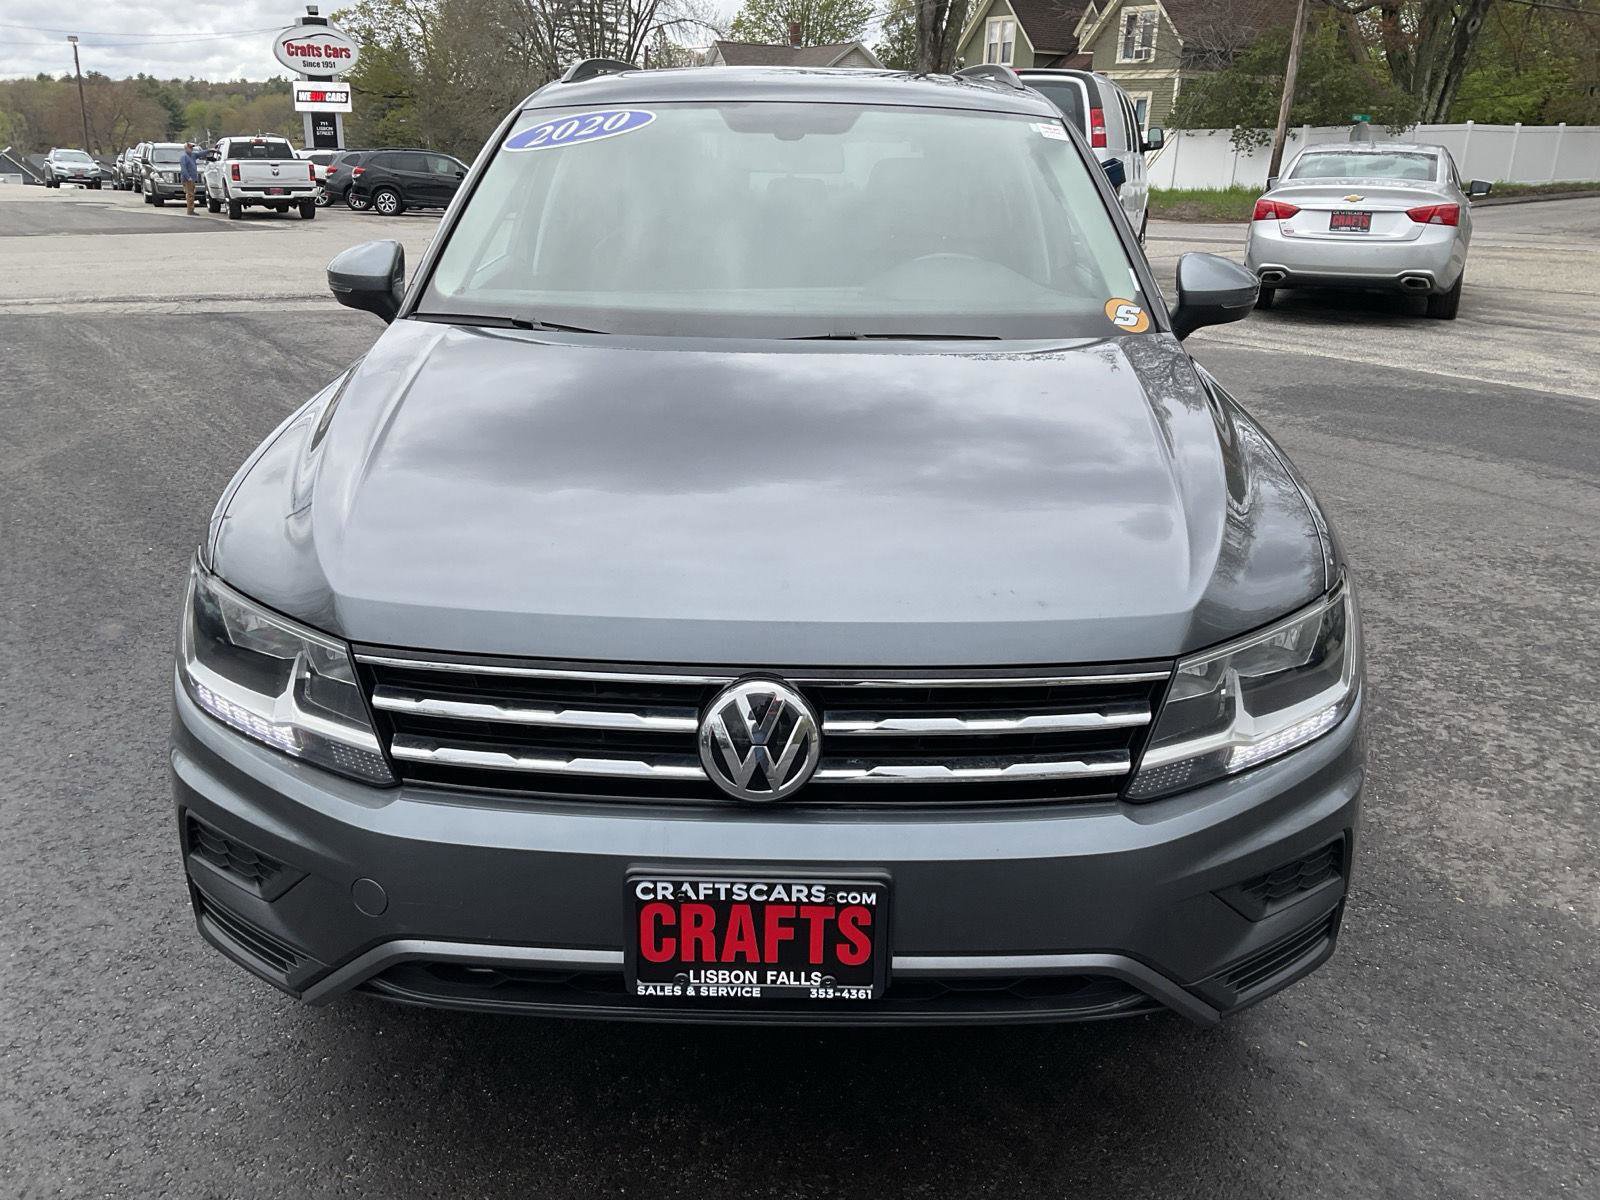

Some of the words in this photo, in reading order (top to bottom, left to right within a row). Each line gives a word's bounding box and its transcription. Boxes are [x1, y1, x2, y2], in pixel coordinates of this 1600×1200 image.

[286, 43, 322, 58] Crafts
[324, 44, 351, 59] Cars
[302, 60, 320, 68] Since
[322, 60, 336, 68] 1951
[524, 111, 631, 148] 2020
[640, 902, 872, 966] CRAFTS
[689, 969, 757, 984] LISBON
[766, 970, 822, 986] FALLS
[637, 985, 682, 996] SALES
[686, 985, 696, 996] &
[700, 986, 761, 997] SERVICE
[810, 988, 872, 1000] 353-4361
